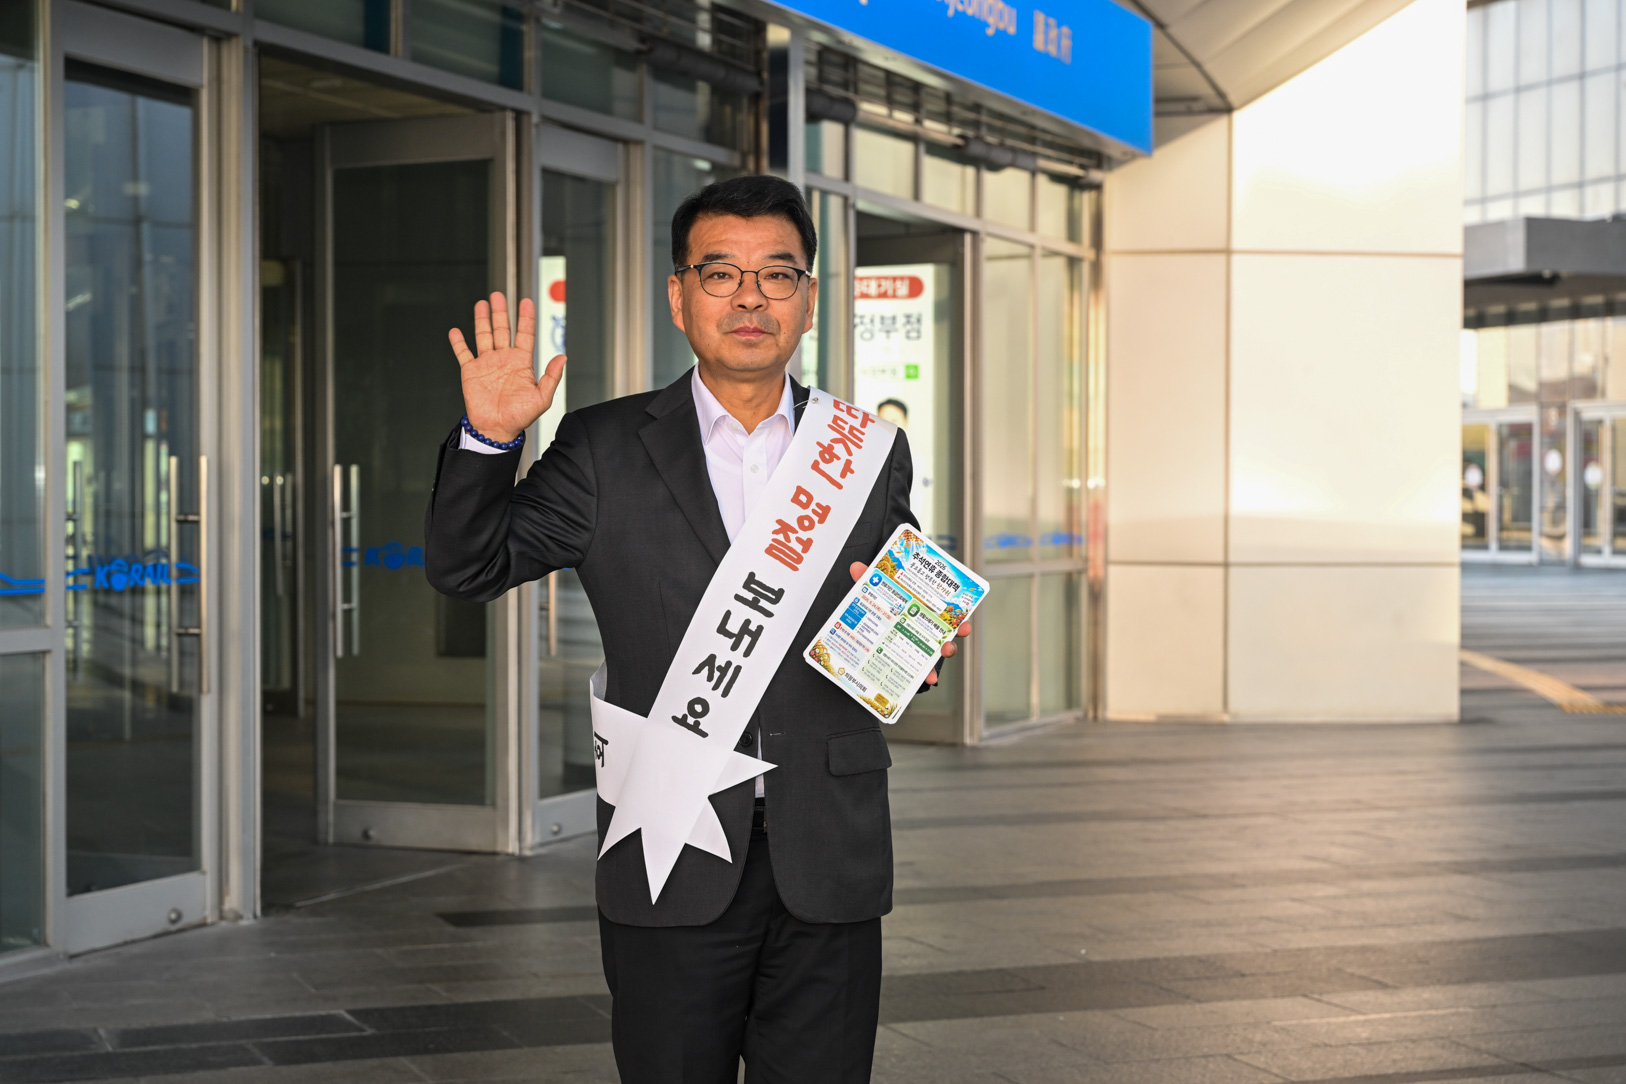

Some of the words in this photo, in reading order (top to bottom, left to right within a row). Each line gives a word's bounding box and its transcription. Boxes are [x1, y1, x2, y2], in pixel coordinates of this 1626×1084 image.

[764, 485, 832, 572] 명절
[912, 551, 937, 574] 추석연휴
[935, 559, 947, 571] 2026
[671, 571, 786, 739] 보내세요
